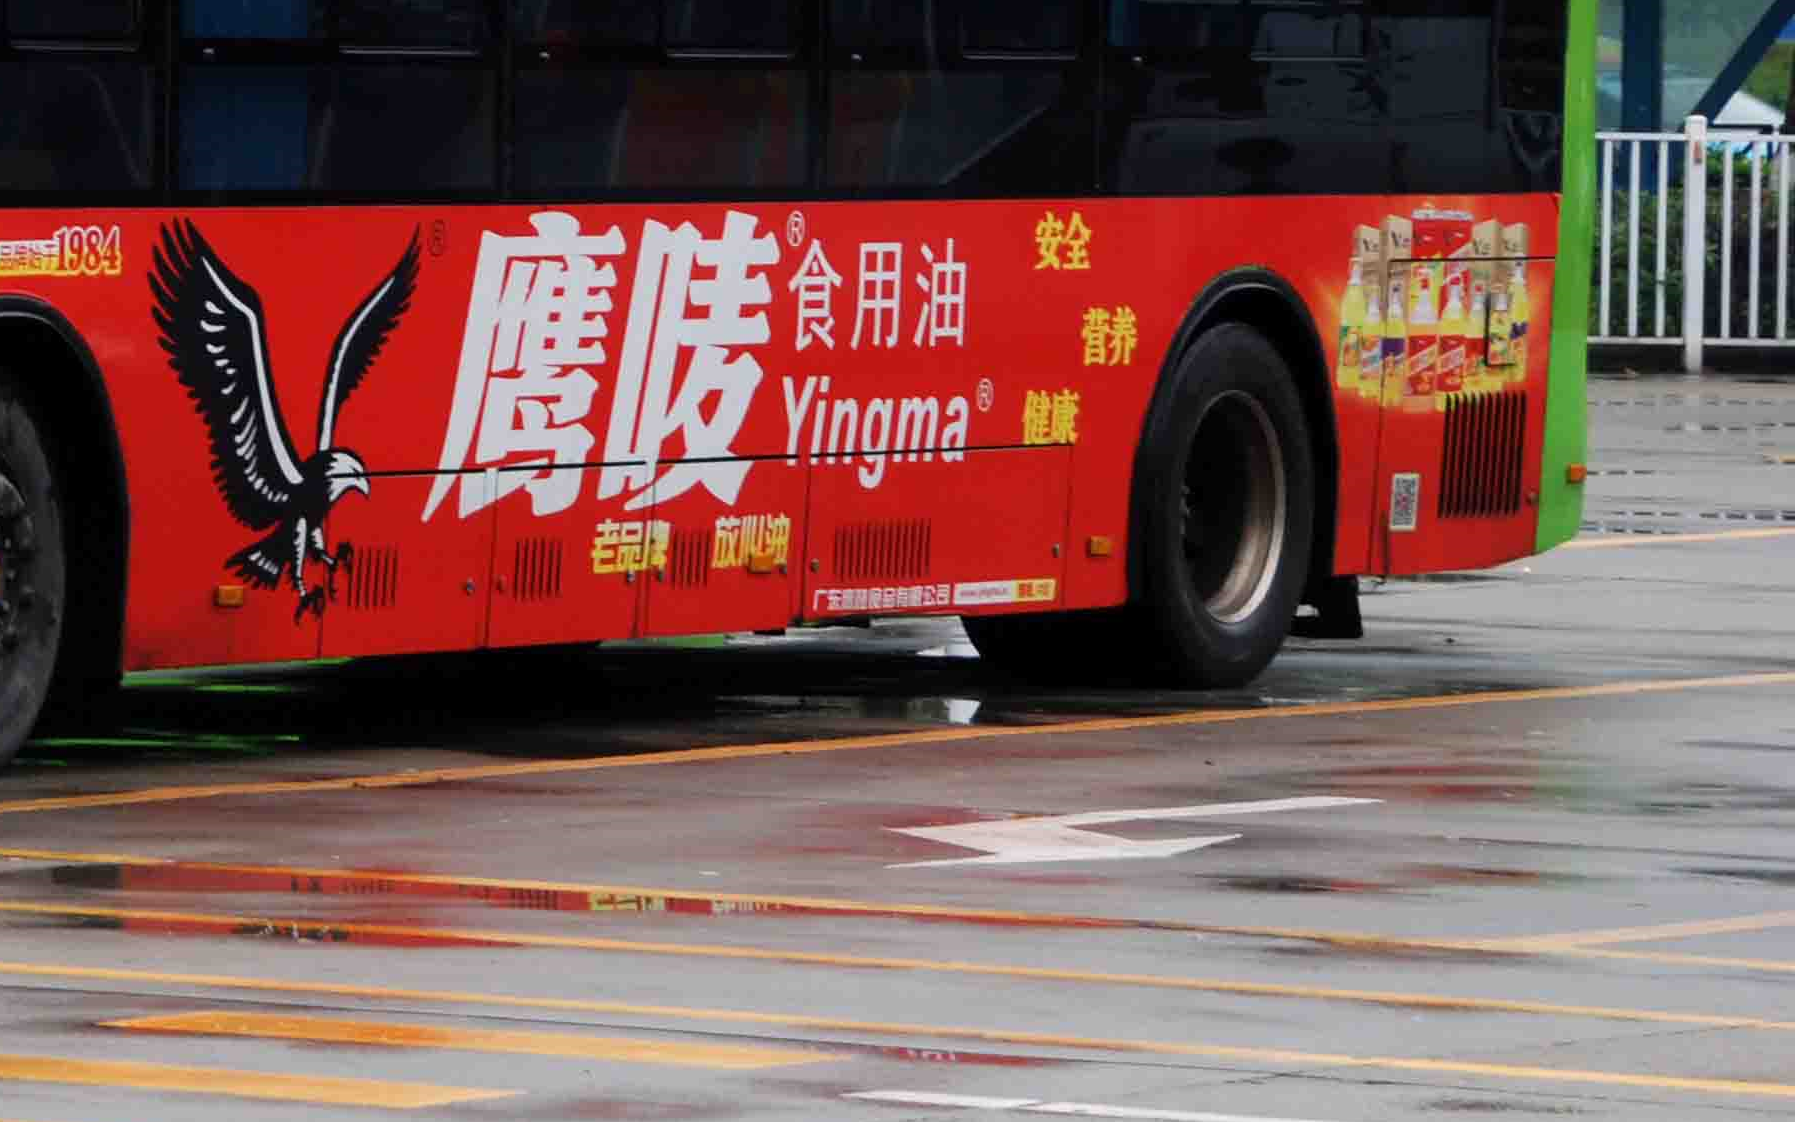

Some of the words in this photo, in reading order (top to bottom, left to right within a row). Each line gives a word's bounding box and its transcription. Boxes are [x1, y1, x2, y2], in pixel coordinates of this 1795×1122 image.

[1034, 210, 1092, 271] 安全
[787, 237, 967, 351] 食用油
[1081, 305, 1138, 367] 营养
[781, 375, 971, 490] Yingma
[1022, 387, 1080, 446] 健康
[591, 517, 671, 575] 老品牌
[711, 511, 792, 569] 放心油
